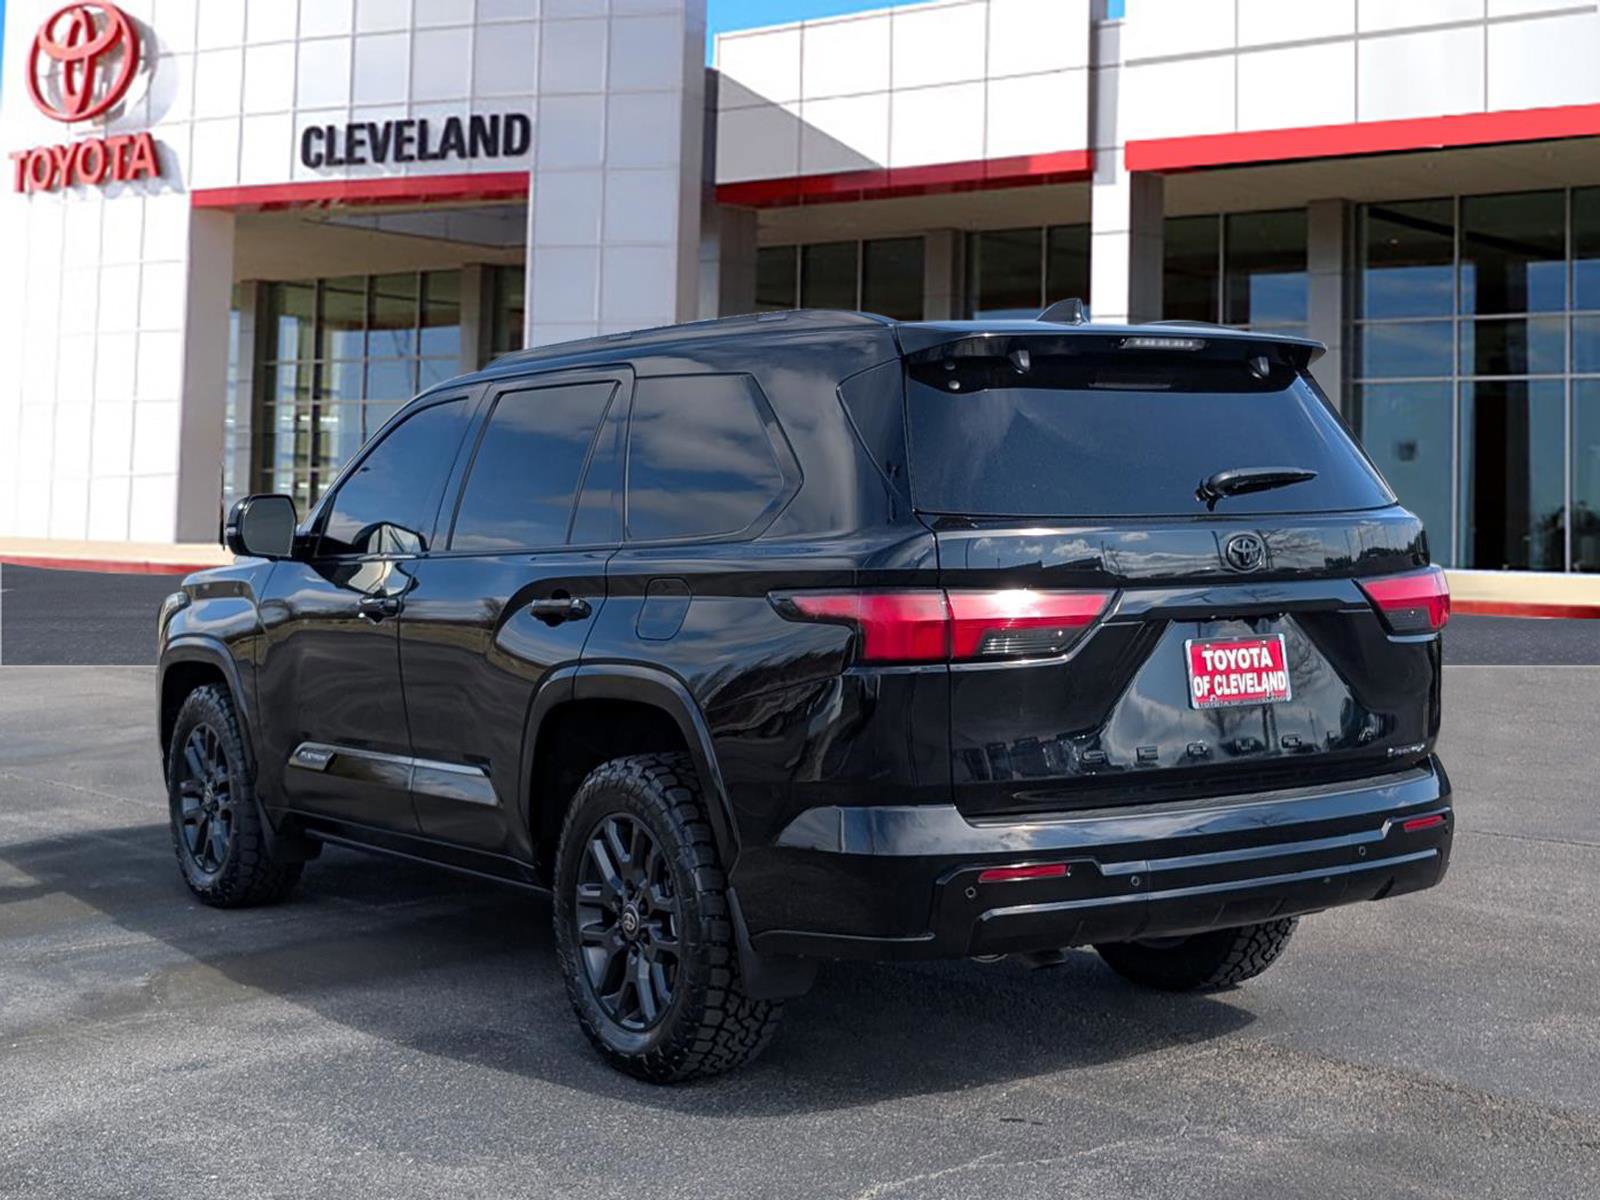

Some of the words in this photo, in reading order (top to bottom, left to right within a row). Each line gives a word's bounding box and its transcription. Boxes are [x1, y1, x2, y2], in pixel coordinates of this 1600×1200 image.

[301, 113, 531, 168] CLEVELAND
[9, 132, 161, 194] TOYOTA
[1202, 647, 1274, 672] TOYOTA
[1193, 675, 1211, 697] OF
[1214, 671, 1287, 696] CLEVELAND
